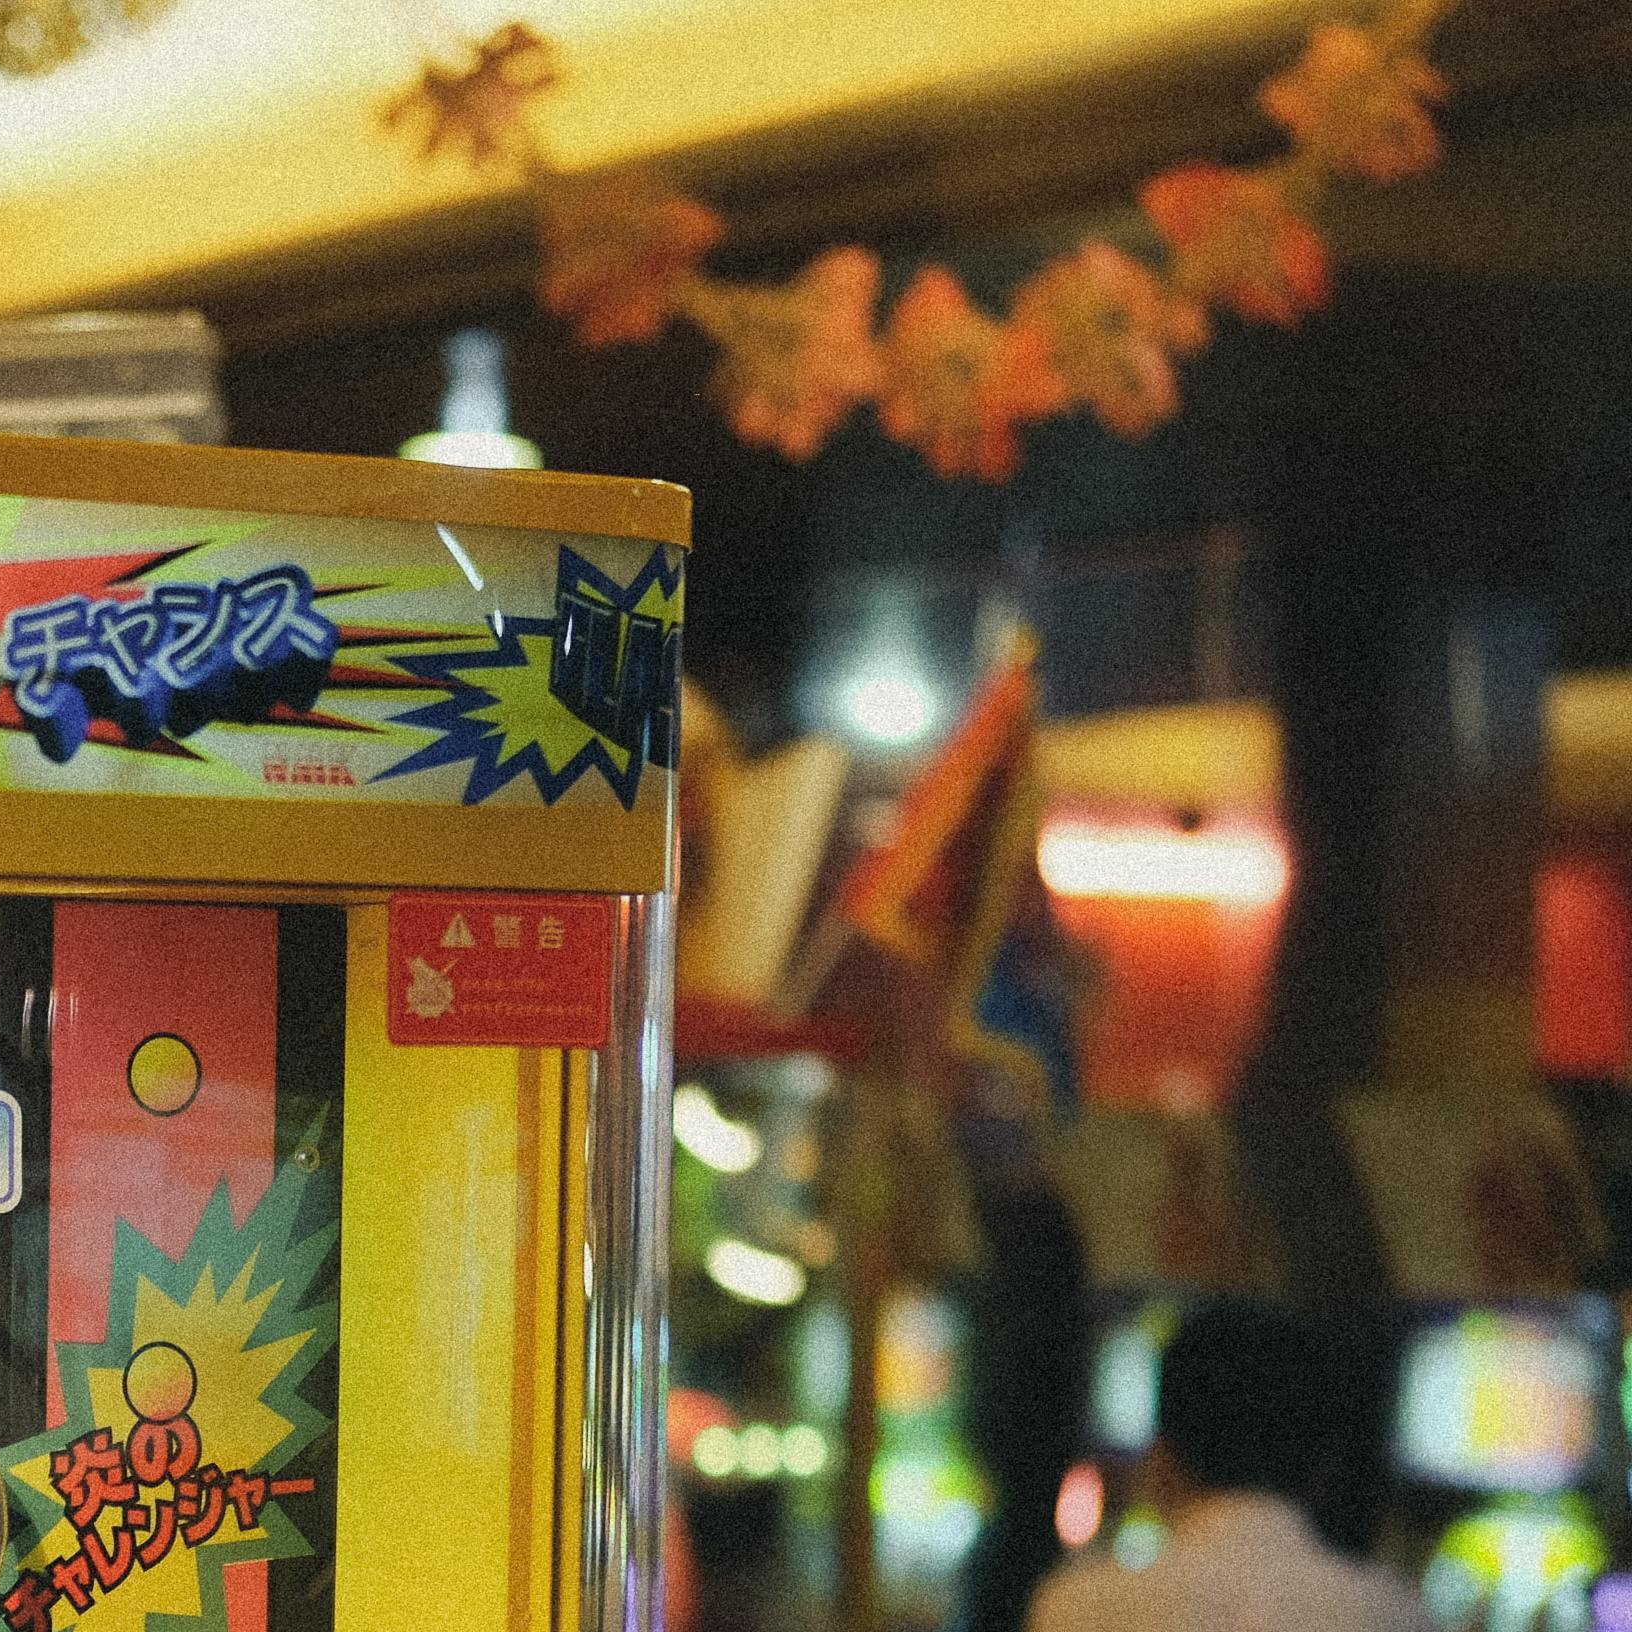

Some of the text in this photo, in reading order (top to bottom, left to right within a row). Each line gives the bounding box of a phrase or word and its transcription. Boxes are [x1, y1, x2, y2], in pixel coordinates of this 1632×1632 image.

[8, 572, 330, 705] チャンス
[50, 1418, 202, 1532] 炎の
